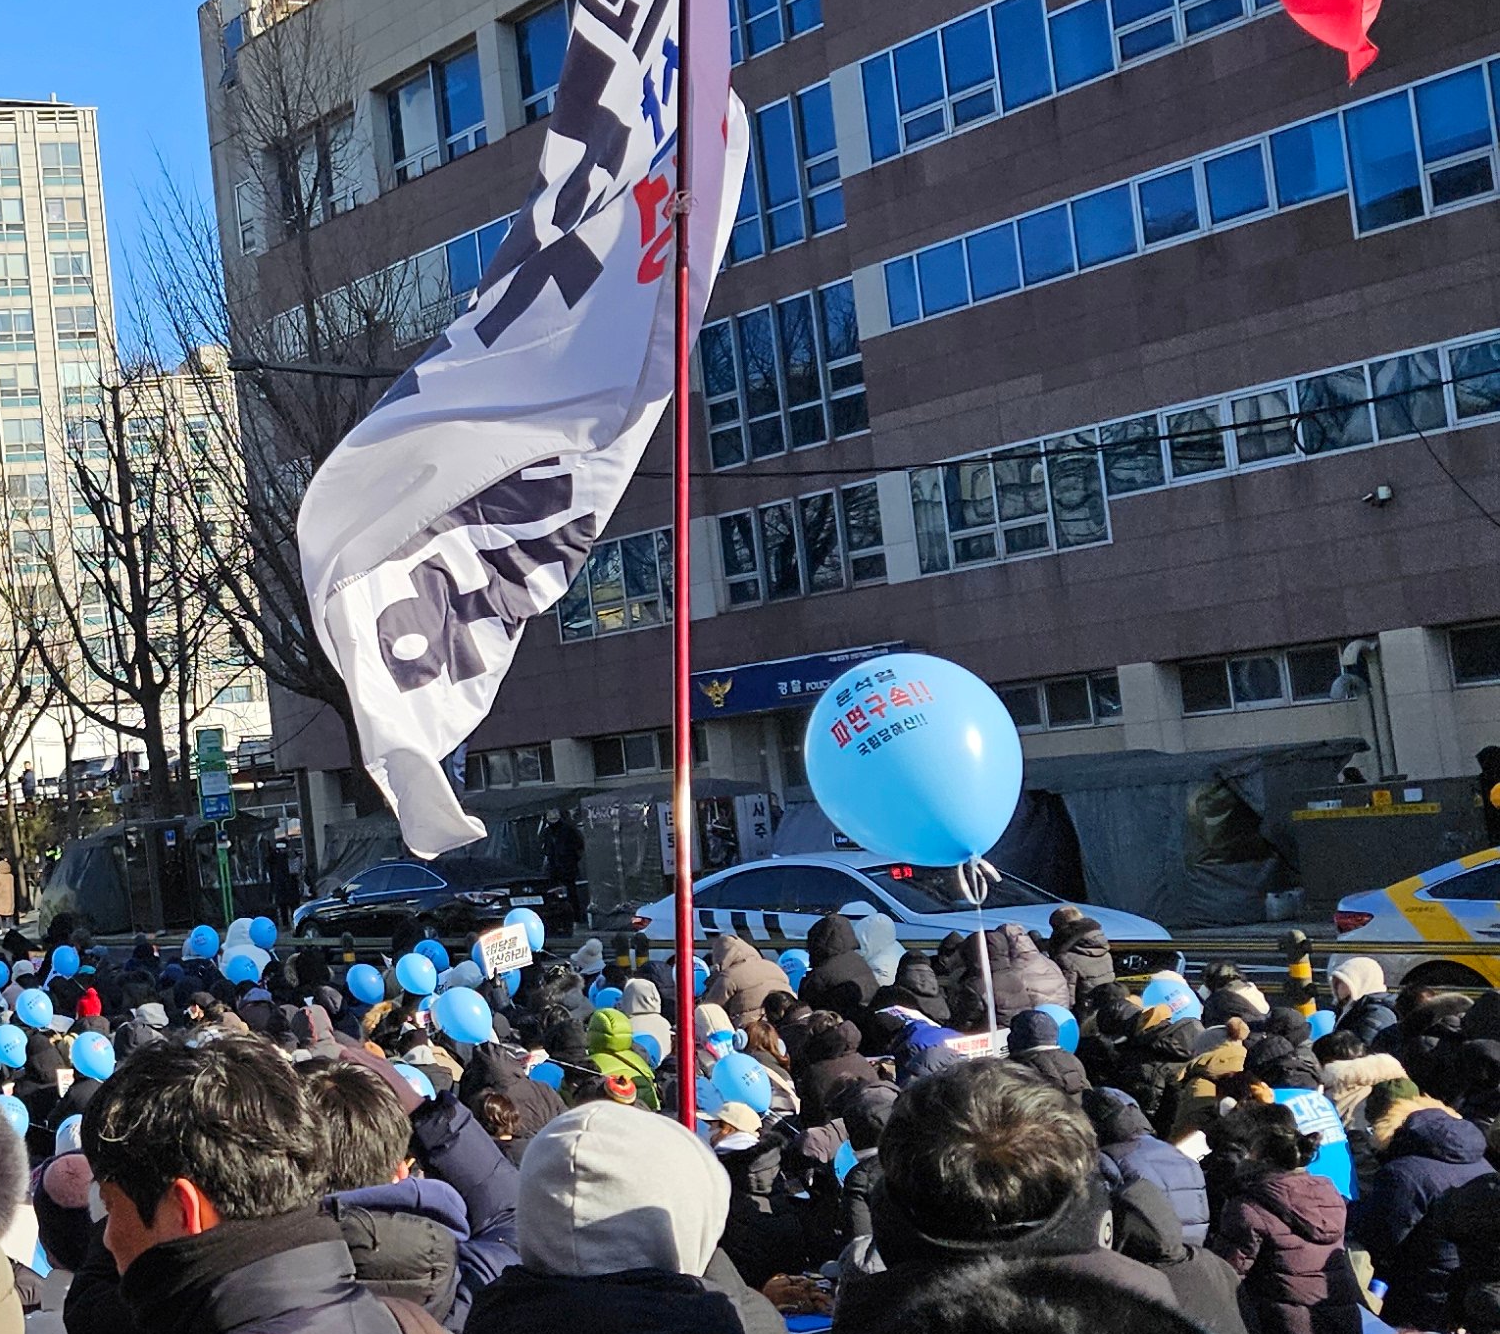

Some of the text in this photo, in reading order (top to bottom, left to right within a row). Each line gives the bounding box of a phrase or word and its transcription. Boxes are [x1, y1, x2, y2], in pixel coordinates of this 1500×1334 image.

[836, 668, 897, 707] 윤석열
[830, 680, 934, 749] 파면구속!!
[856, 712, 929, 756] 국힘당해산!!
